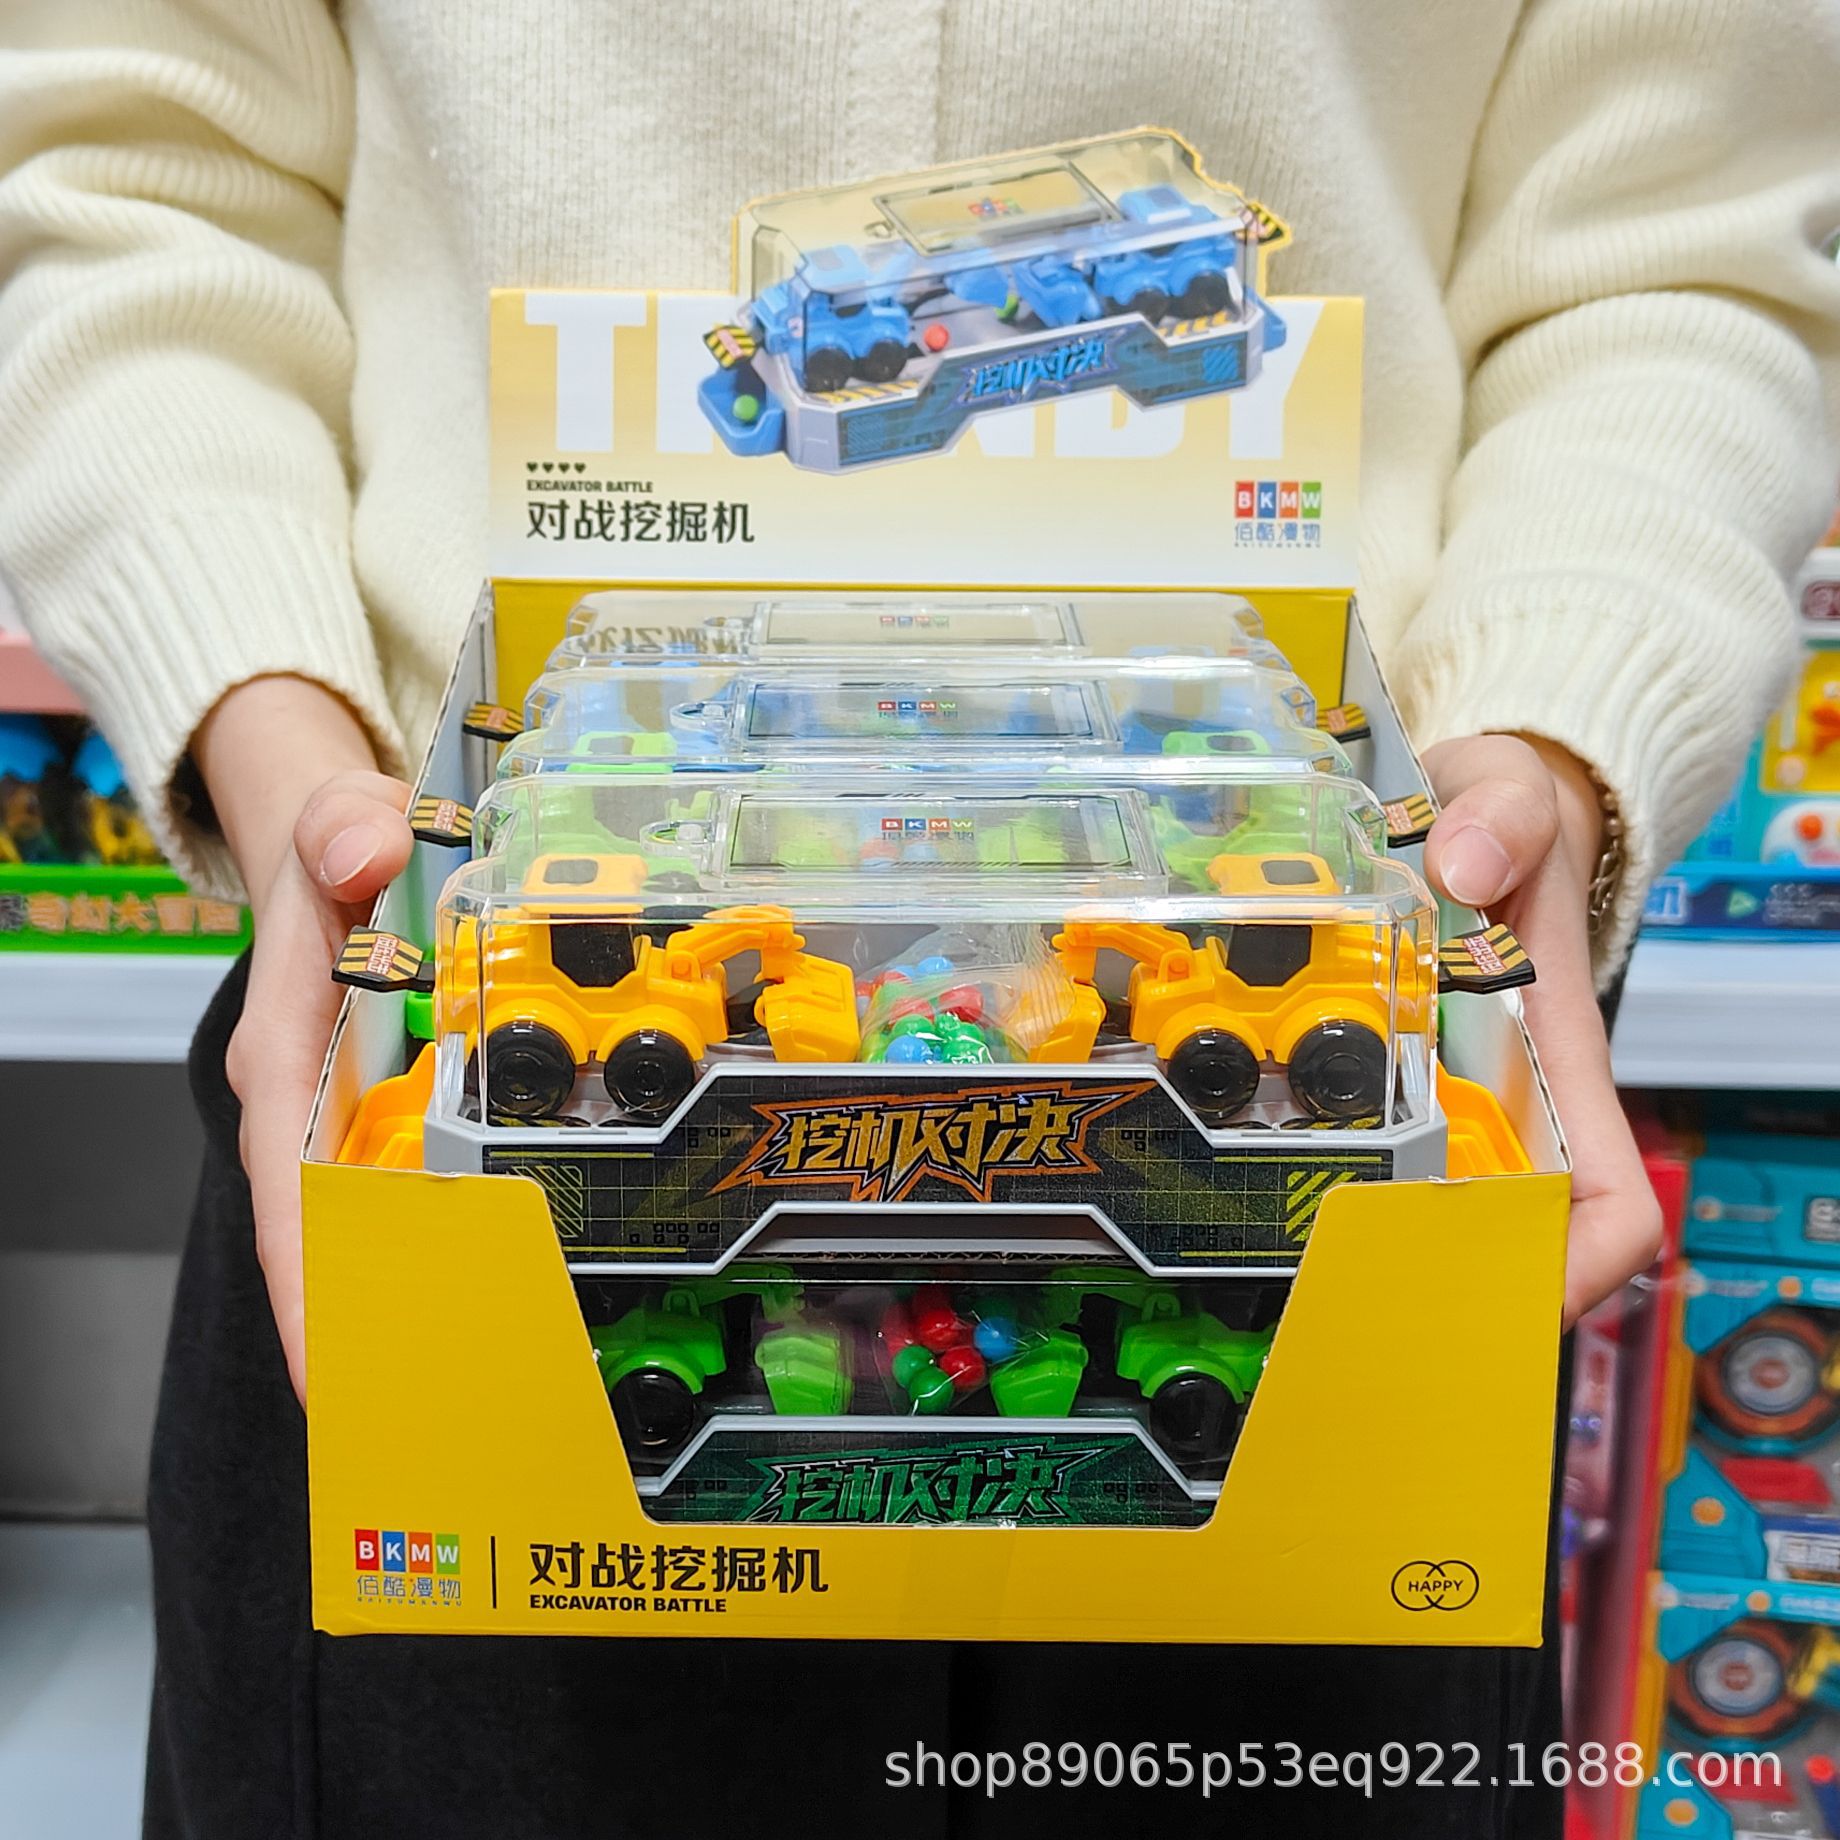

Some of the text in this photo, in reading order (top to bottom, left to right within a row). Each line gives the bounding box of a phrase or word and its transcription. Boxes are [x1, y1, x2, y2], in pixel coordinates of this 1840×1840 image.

[526, 479, 654, 493] EXCAVATOR BATTLE
[1236, 489, 1322, 510] BKMW
[526, 498, 755, 544] 对战挖掘机
[771, 1097, 1088, 1190] 挖机对决
[357, 1539, 460, 1565] BKMW
[529, 1541, 829, 1594] 对战挖掘机
[1407, 1579, 1465, 1593] HAPPY
[529, 1593, 728, 1613] EXCAVATOR BATTLE
